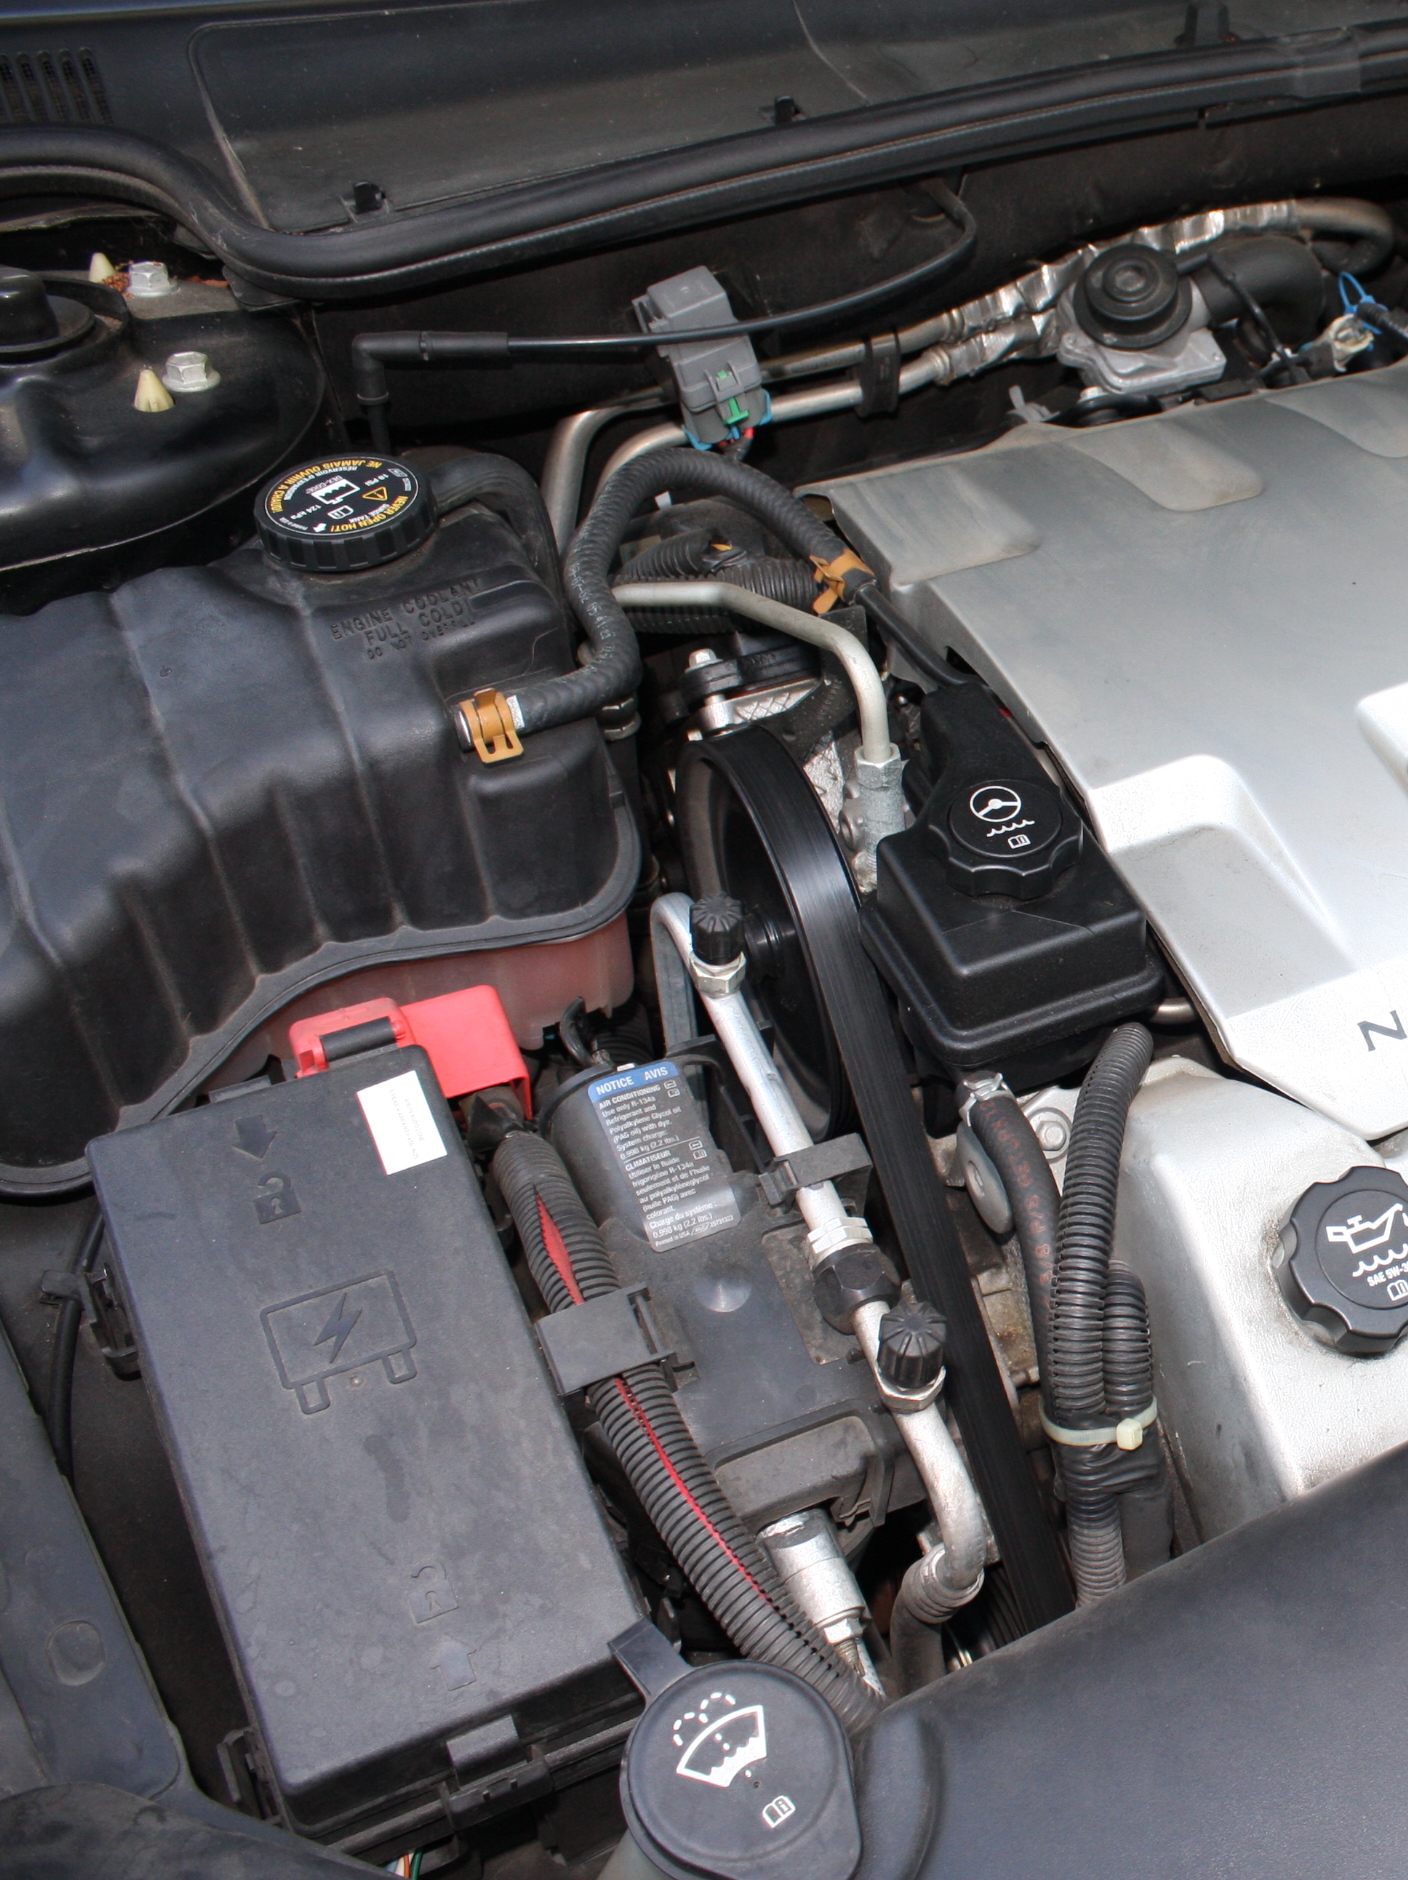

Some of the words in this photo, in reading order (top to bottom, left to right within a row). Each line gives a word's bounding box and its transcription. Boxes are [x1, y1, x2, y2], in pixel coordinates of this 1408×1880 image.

[322, 460, 367, 470] JAMAIS
[366, 461, 383, 469] NE
[306, 504, 321, 514] 124
[384, 495, 409, 514] NEVER
[330, 522, 358, 532] HOT!
[360, 512, 387, 528] OPEN
[330, 607, 393, 640] ENGINE
[402, 578, 481, 614] COOLANT
[365, 621, 409, 647] FULL
[418, 600, 464, 627] COLD
[596, 1075, 633, 1095] NOTICE
[644, 1066, 668, 1080] AVIS
[599, 1099, 611, 1109] AIR
[612, 1084, 660, 1103] CONDITIONING
[631, 1095, 655, 1107] R-134a
[625, 1150, 671, 1171] CLIMATISEUR
[1366, 1269, 1387, 1287] SAE
